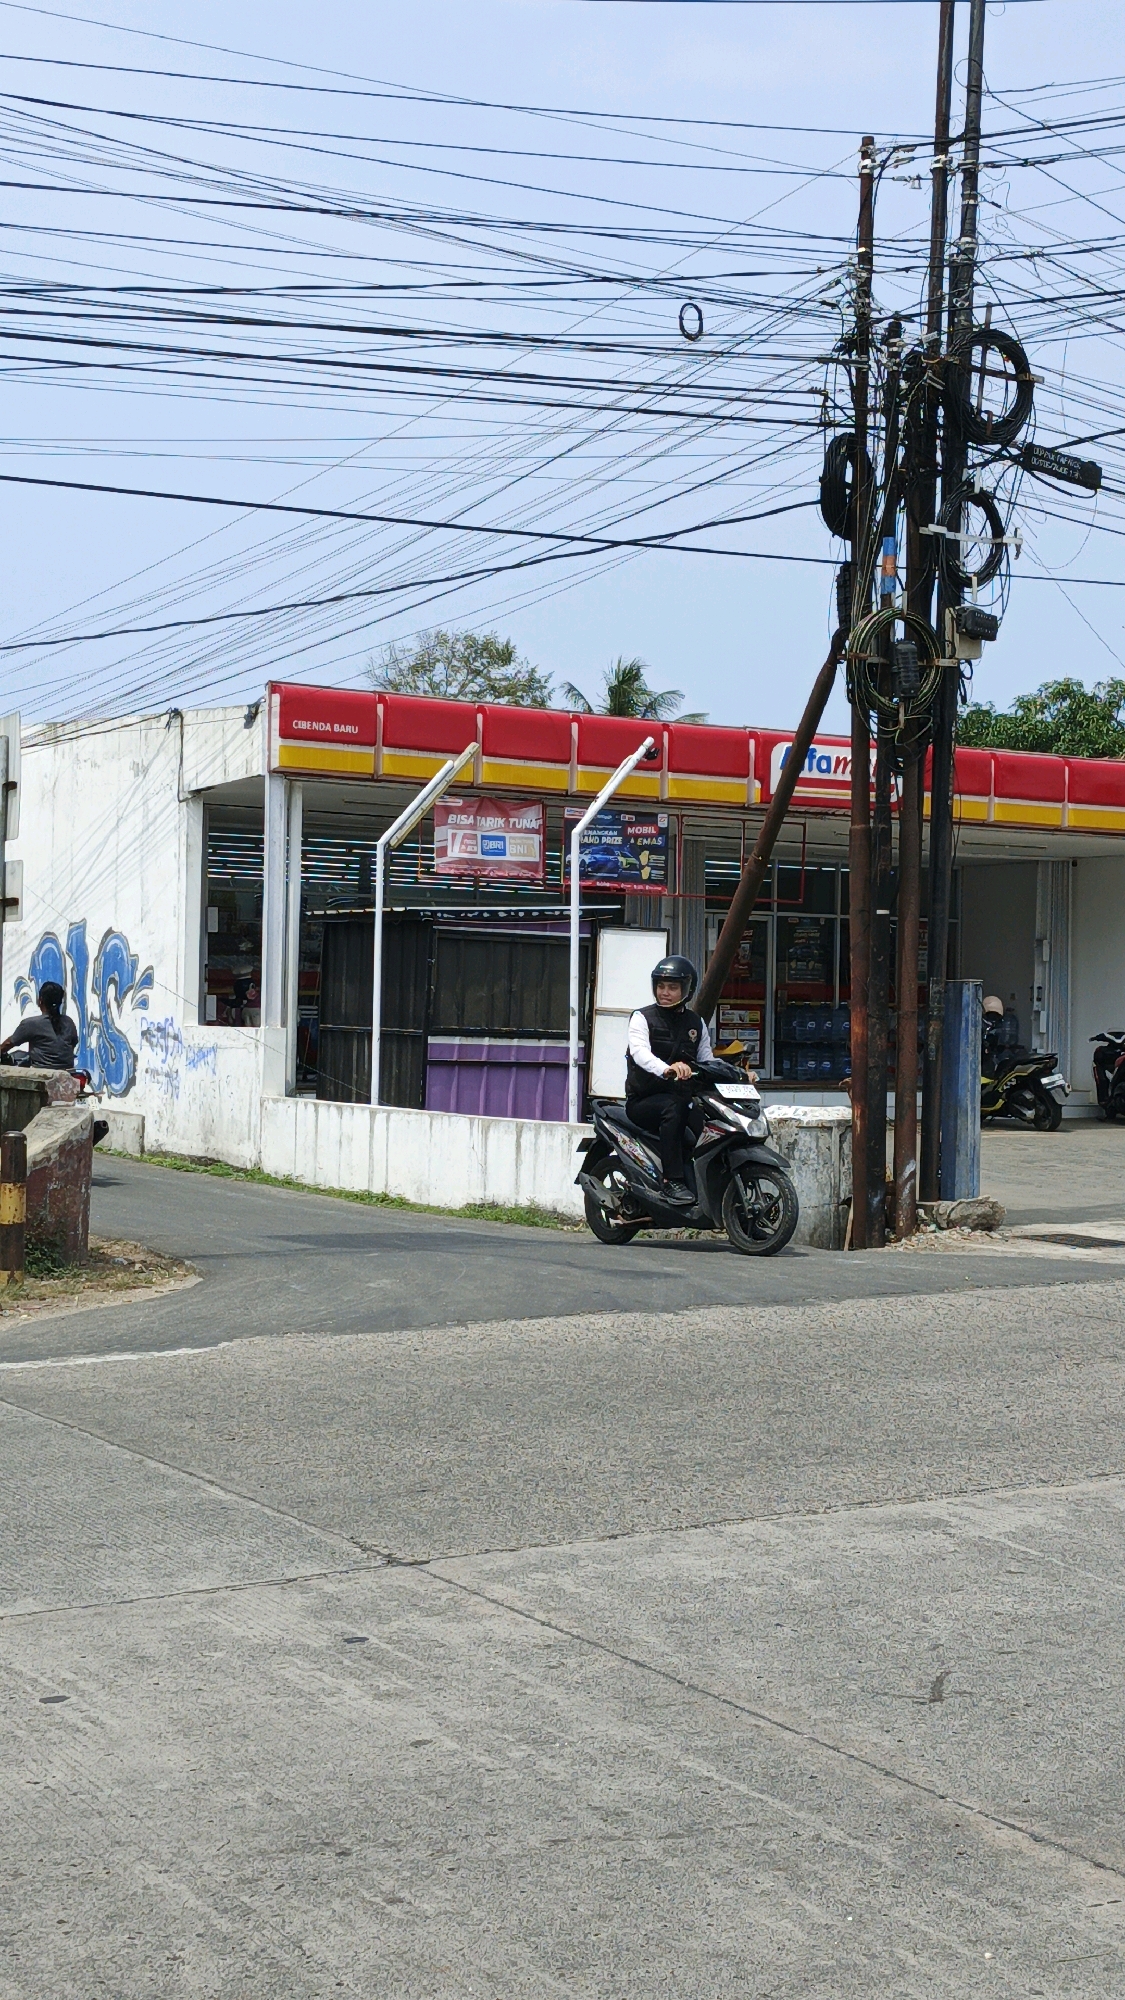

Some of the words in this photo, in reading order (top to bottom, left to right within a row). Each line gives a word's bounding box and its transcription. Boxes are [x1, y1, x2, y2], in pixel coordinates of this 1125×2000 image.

[292, 719, 331, 732] CIBENDA
[333, 723, 359, 734] BARU
[447, 814, 474, 826] BISA
[476, 816, 506, 829] TARIK
[627, 826, 657, 835] MOBIL
[601, 836, 623, 845] PRIZE
[636, 837, 663, 846] EMAS
[509, 844, 527, 855] BNI
